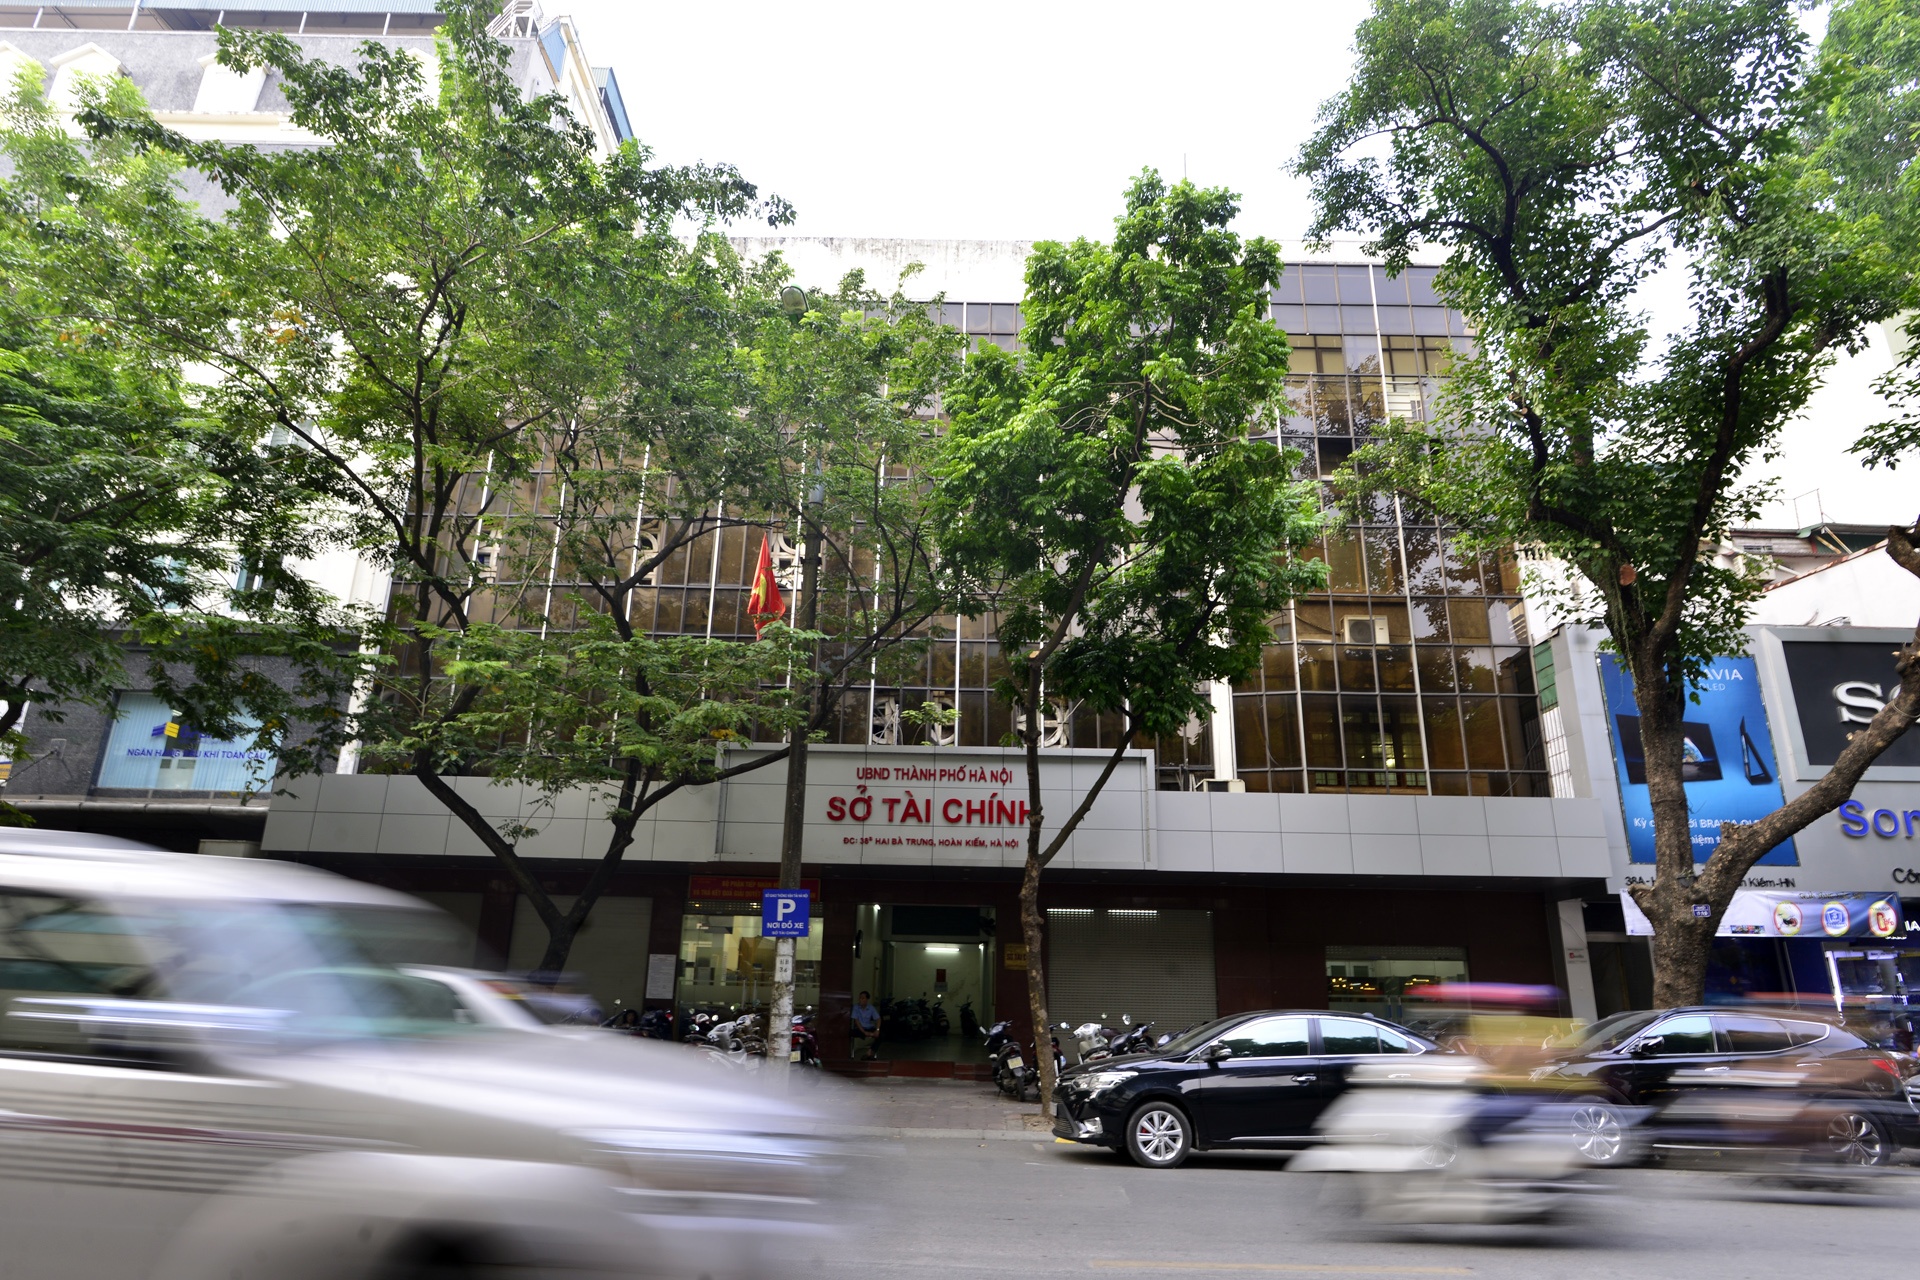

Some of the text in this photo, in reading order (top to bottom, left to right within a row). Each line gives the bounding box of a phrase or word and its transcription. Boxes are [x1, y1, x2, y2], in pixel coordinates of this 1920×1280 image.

[856, 764, 1012, 786] UBND THÀNH PHỐ HÀ NỘI
[826, 784, 873, 822] SỞ
[882, 790, 931, 823] TÀI
[875, 837, 890, 846] HAI
[891, 836, 904, 846] BÀ
[906, 837, 936, 848] TRƯNG,
[938, 837, 962, 847] HOÀN
[990, 838, 1002, 848] HÀ
[1004, 838, 1019, 850] NỘI
[777, 898, 796, 922] P
